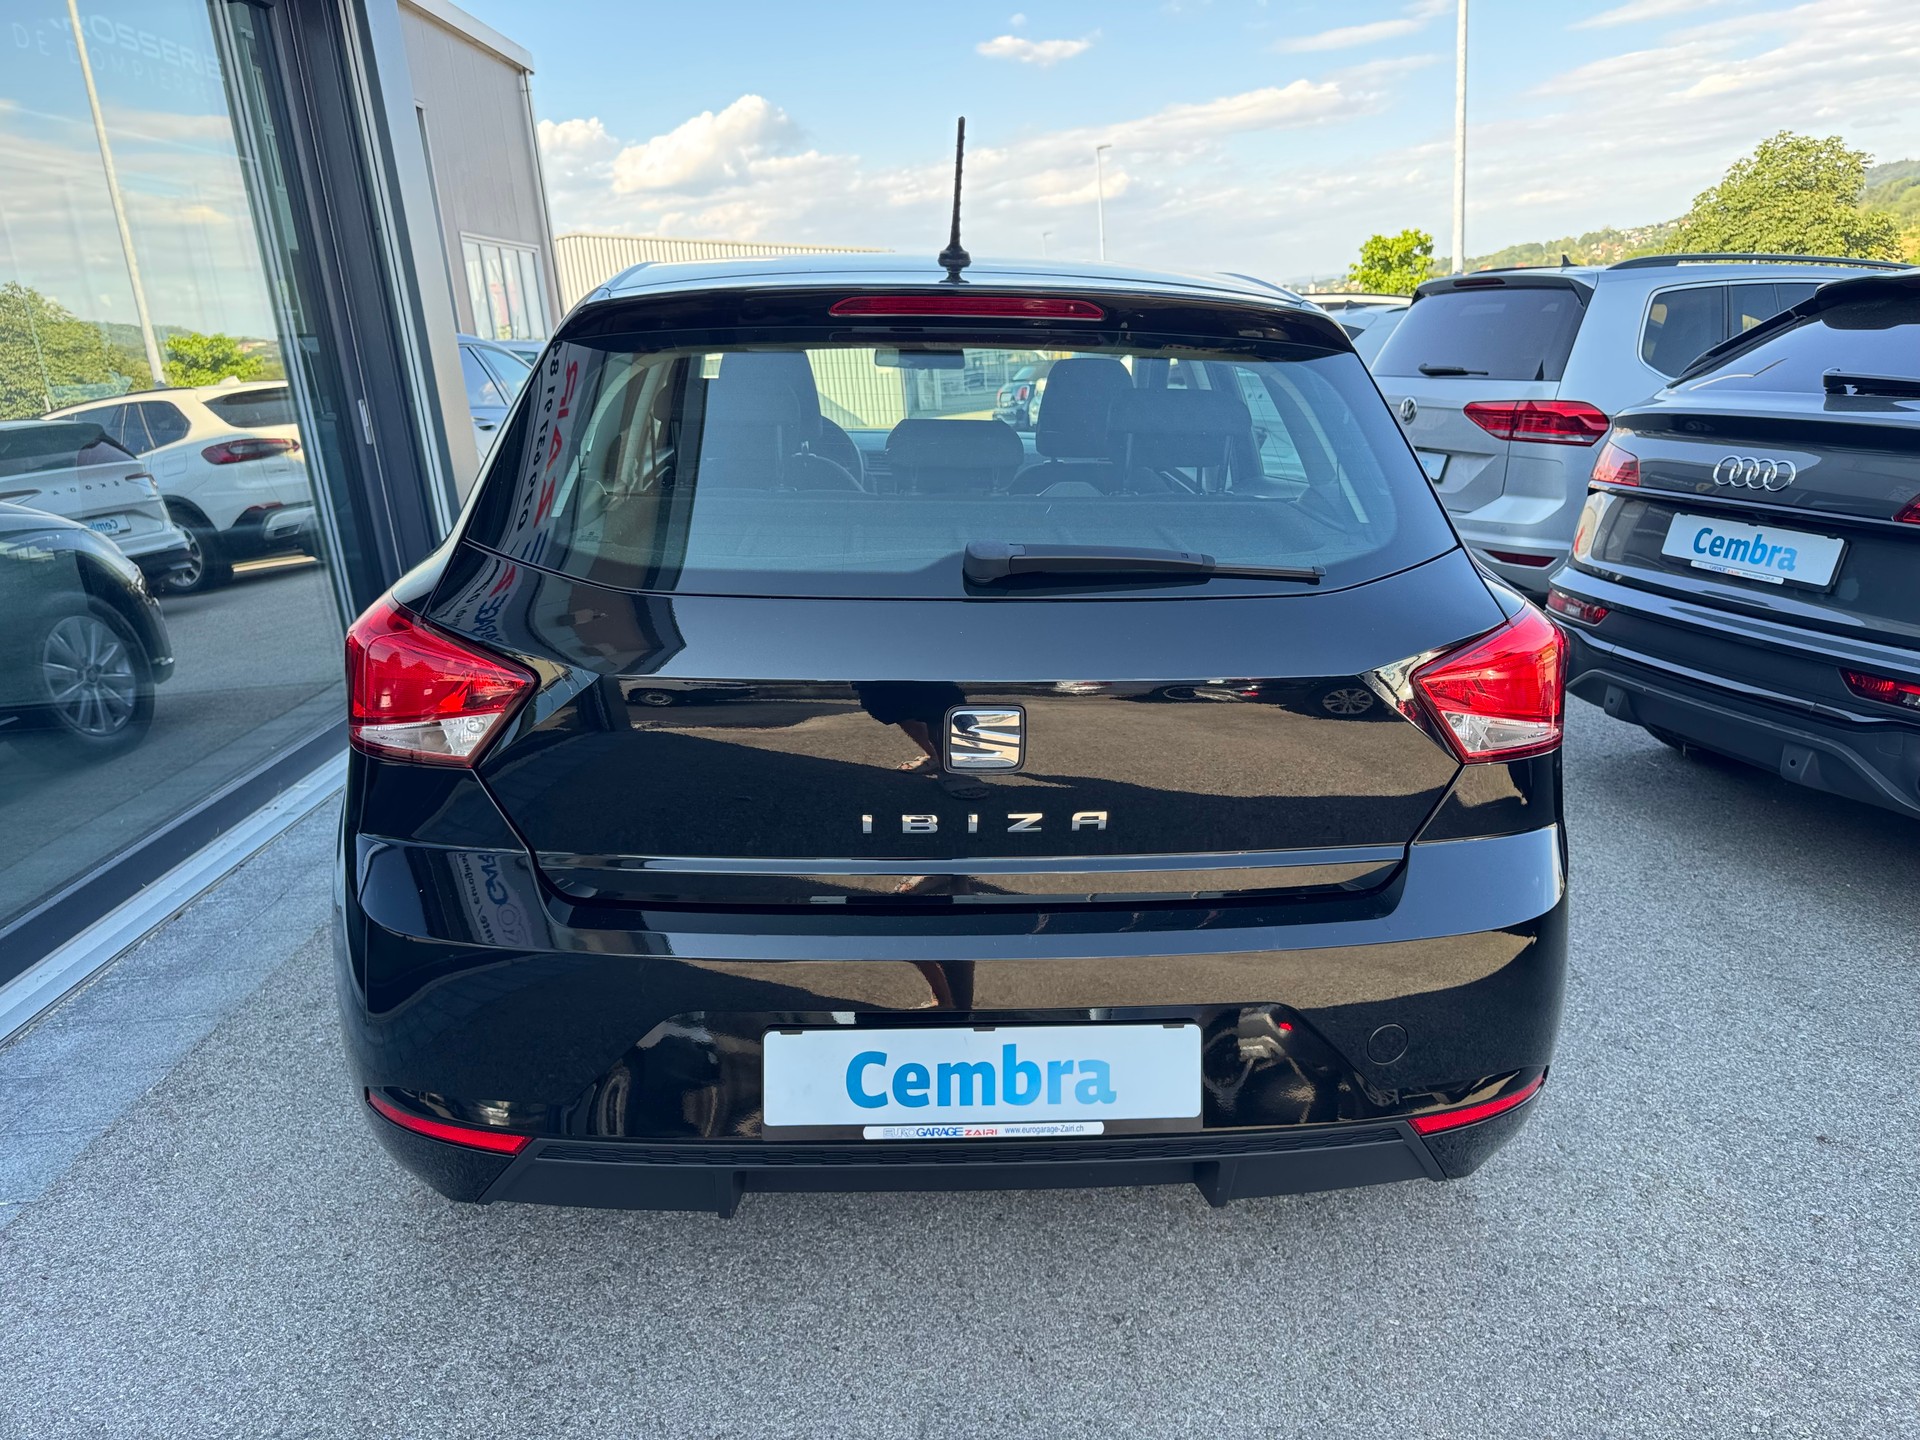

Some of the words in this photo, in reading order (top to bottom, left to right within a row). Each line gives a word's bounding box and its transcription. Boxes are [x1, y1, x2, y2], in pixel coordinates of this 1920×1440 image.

[1693, 527, 1798, 572] Cembra
[862, 811, 1107, 834] IBIZA
[846, 1043, 1117, 1108] Cembra
